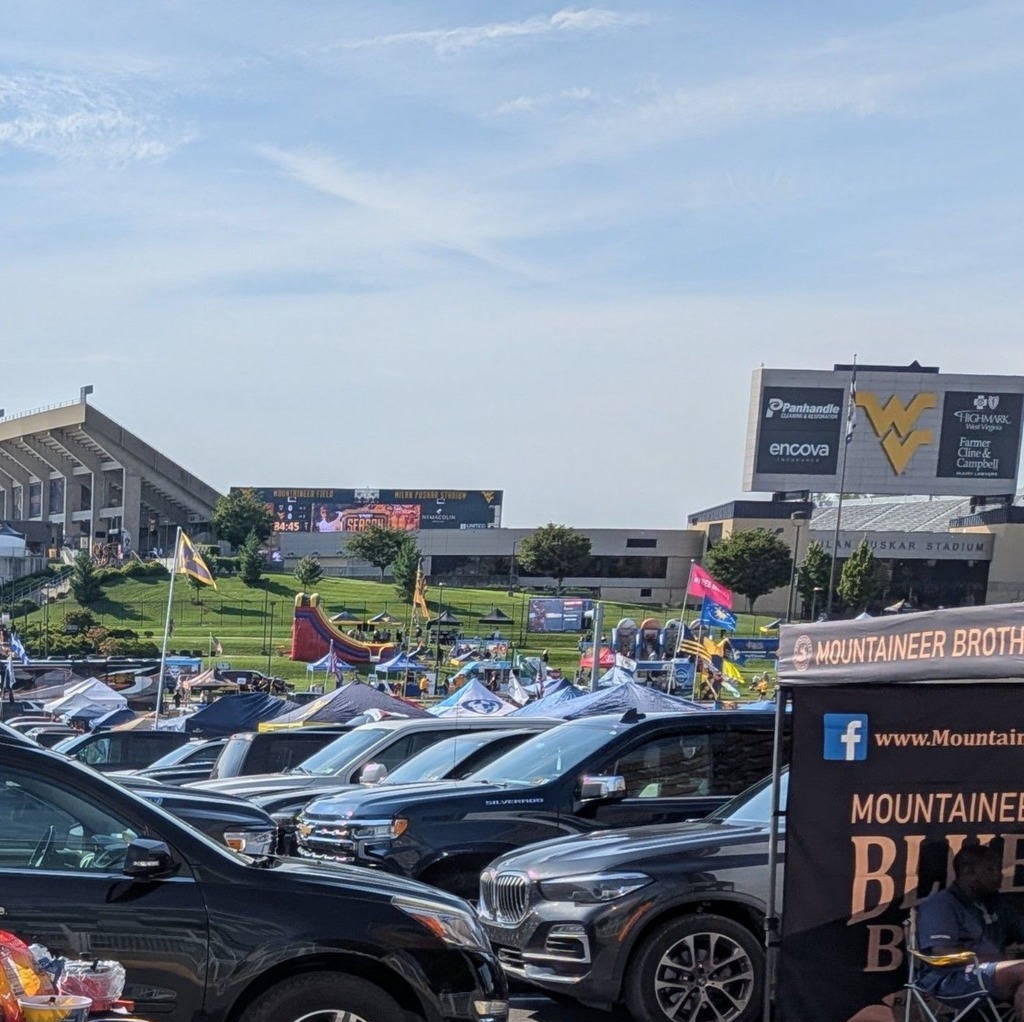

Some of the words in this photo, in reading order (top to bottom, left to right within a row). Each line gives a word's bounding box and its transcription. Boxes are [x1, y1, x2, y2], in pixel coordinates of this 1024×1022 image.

[782, 402, 840, 414] Panhandle
[959, 436, 991, 448] Farmer
[769, 442, 830, 457] encova
[957, 446, 981, 458] Cline
[982, 447, 991, 459] &
[956, 457, 999, 471] Campbell
[316, 489, 334, 498] FIELD
[811, 540, 851, 549] ILAN
[865, 541, 916, 550] USKAR
[926, 542, 984, 551] STADIUM
[816, 631, 947, 665] MOUNTAINEER
[485, 798, 544, 806] SILVERADO
